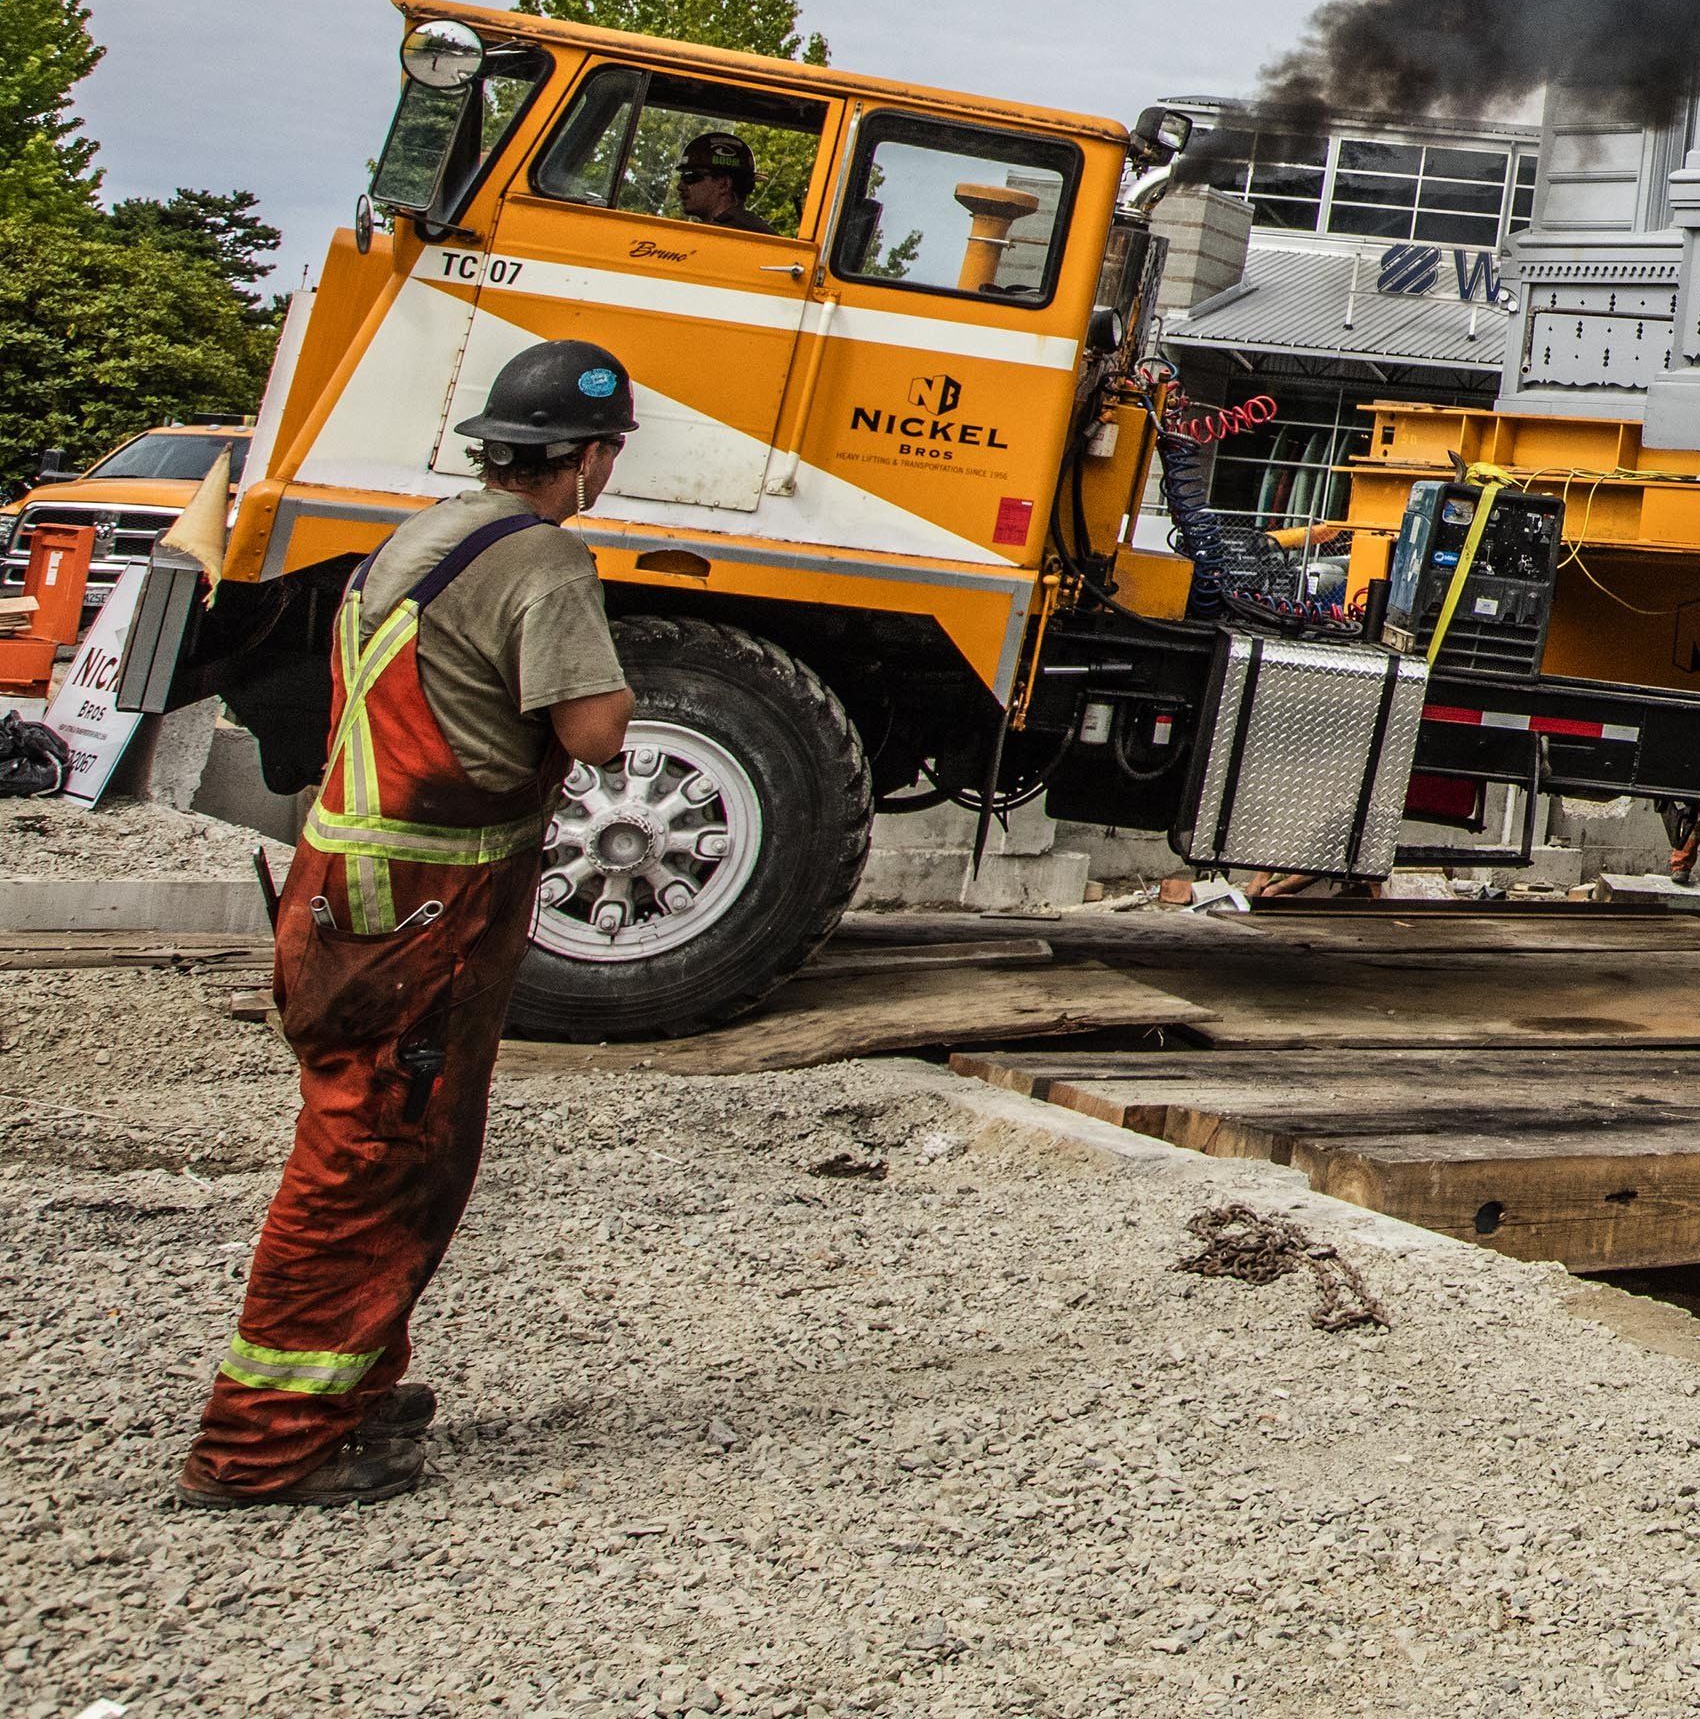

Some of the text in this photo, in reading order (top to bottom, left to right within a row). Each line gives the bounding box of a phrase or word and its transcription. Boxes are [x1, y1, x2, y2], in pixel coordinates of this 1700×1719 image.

[442, 252, 523, 285] TC 07
[851, 407, 1008, 449] NICKEL
[836, 451, 859, 462] HEAVY
[861, 456, 890, 466] LIFTING
[900, 459, 963, 474] TRANSPORTATION
[965, 468, 987, 478] SINCE
[899, 444, 953, 460] BROS
[78, 700, 107, 721] BROS
